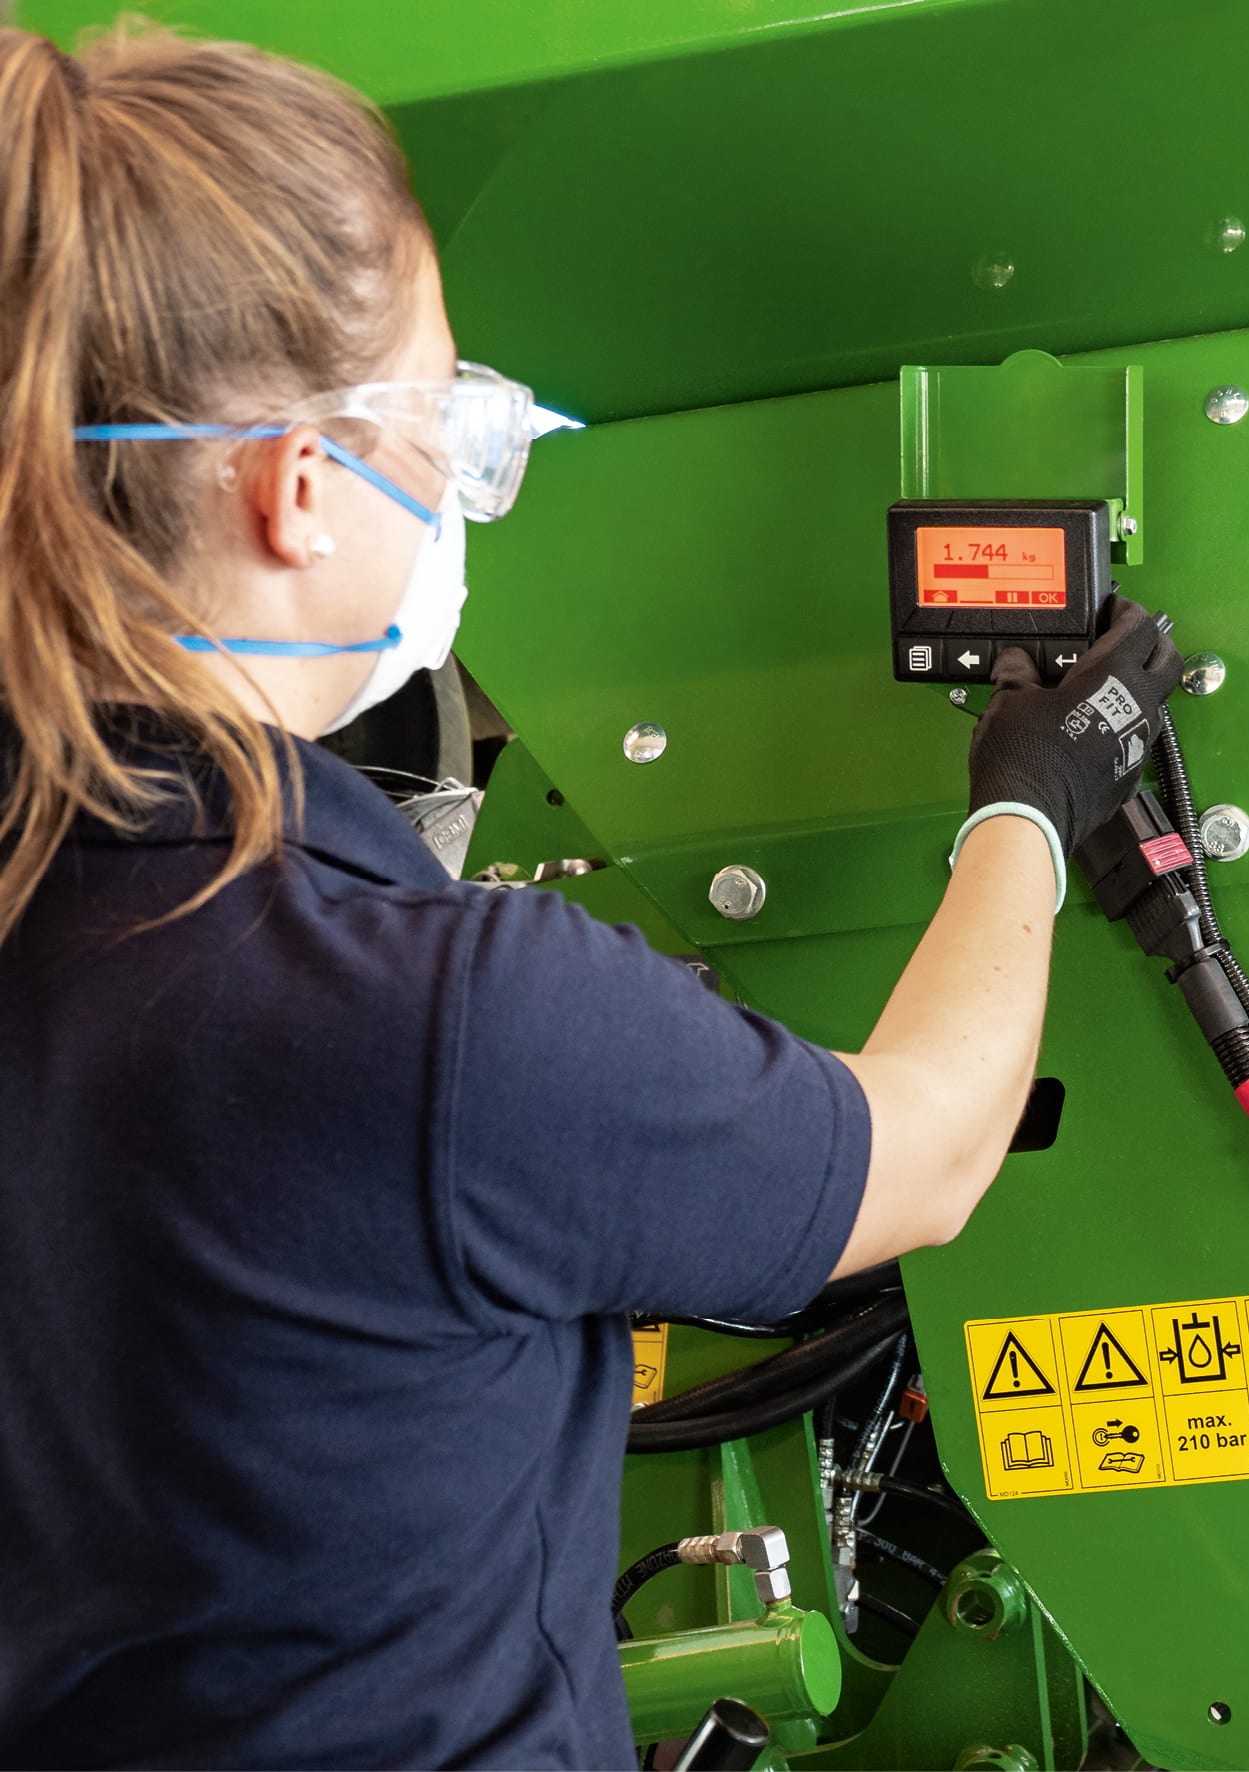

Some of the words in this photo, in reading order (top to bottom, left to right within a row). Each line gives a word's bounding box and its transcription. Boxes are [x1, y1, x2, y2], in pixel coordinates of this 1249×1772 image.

[943, 543, 1008, 561] 1.744
[1022, 552, 1036, 563] kg
[1038, 592, 1058, 604] OK
[1098, 695, 1121, 716] FIT
[1107, 686, 1133, 715] PRO
[1187, 1415, 1232, 1430] max.
[1177, 1433, 1210, 1452] 210
[1215, 1432, 1247, 1448] bar
